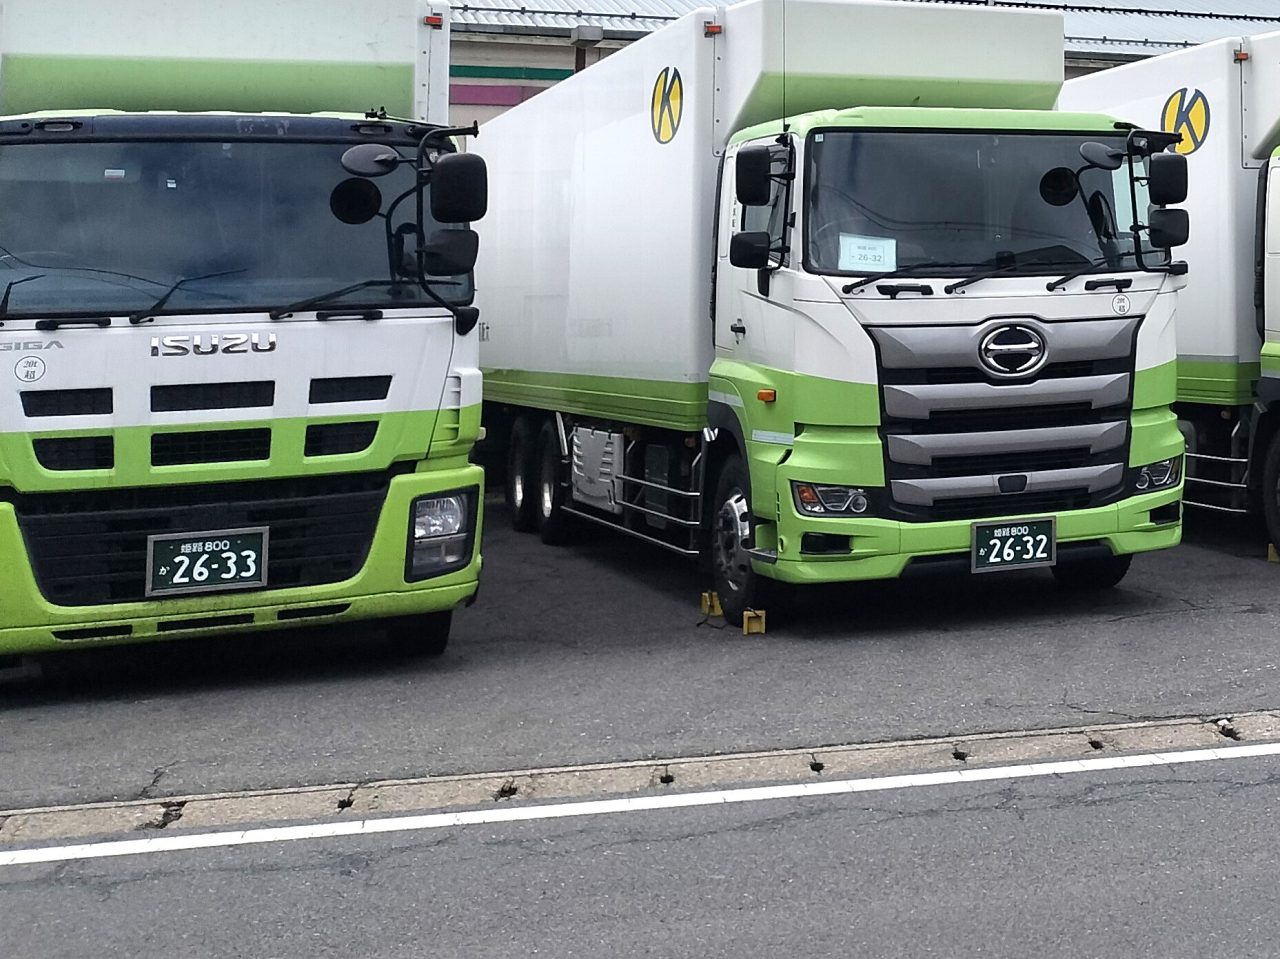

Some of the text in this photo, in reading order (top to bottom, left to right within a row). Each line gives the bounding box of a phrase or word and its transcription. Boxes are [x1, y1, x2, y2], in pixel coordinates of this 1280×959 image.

[0, 340, 64, 351] GIGA
[150, 332, 276, 357] ISUZU
[989, 534, 1048, 563] 26-32
[173, 550, 257, 584] 26-33
